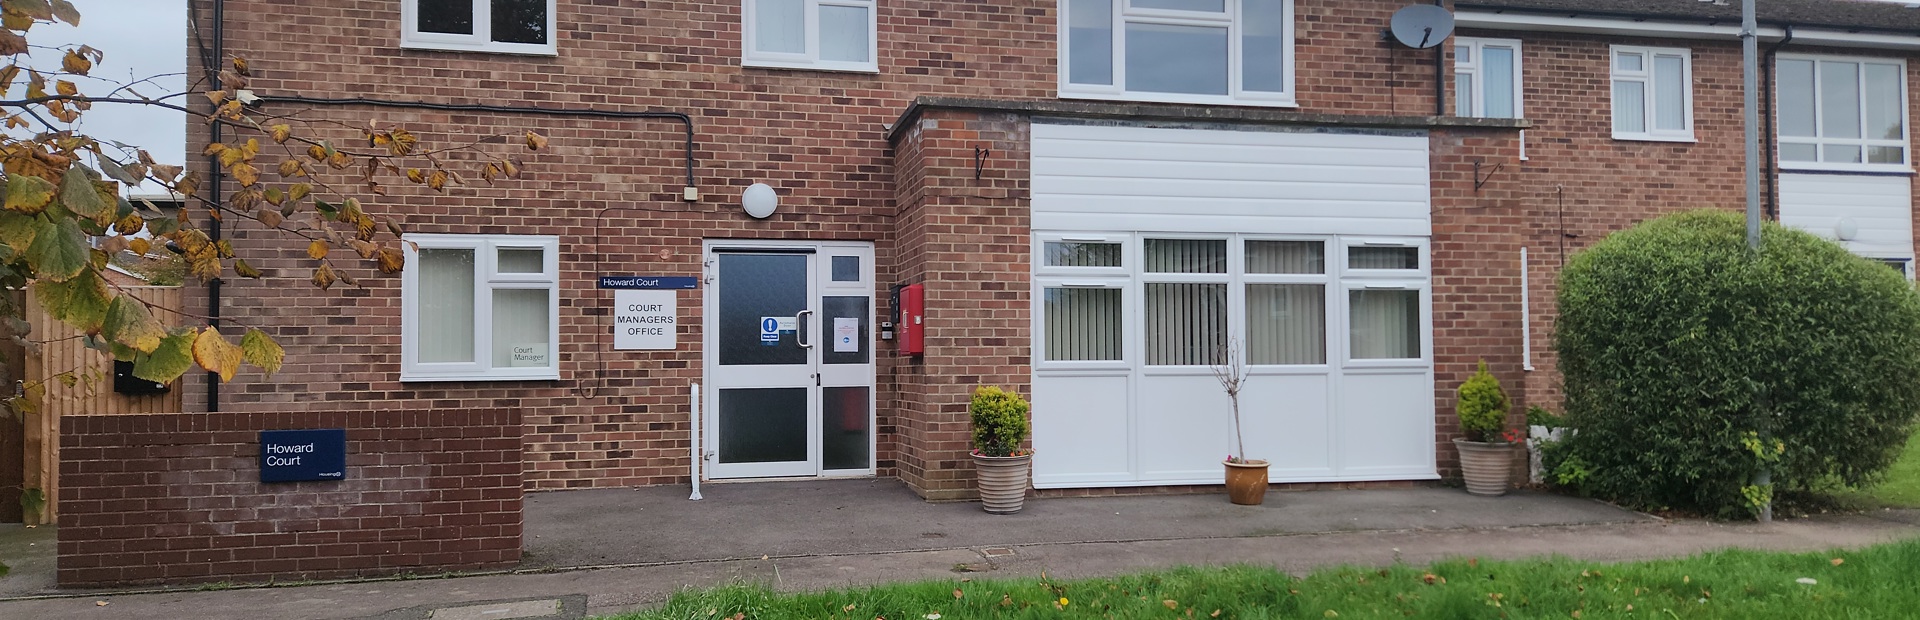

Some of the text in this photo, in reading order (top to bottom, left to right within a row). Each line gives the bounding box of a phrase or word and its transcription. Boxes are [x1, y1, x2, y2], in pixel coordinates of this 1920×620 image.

[603, 278, 659, 286] Howard Court
[628, 304, 663, 312] COURT
[617, 316, 674, 324] MANAGERS
[627, 328, 663, 336] OFFICE
[514, 354, 544, 362] Manager
[266, 442, 314, 454] Howard
[266, 455, 301, 467] Court
